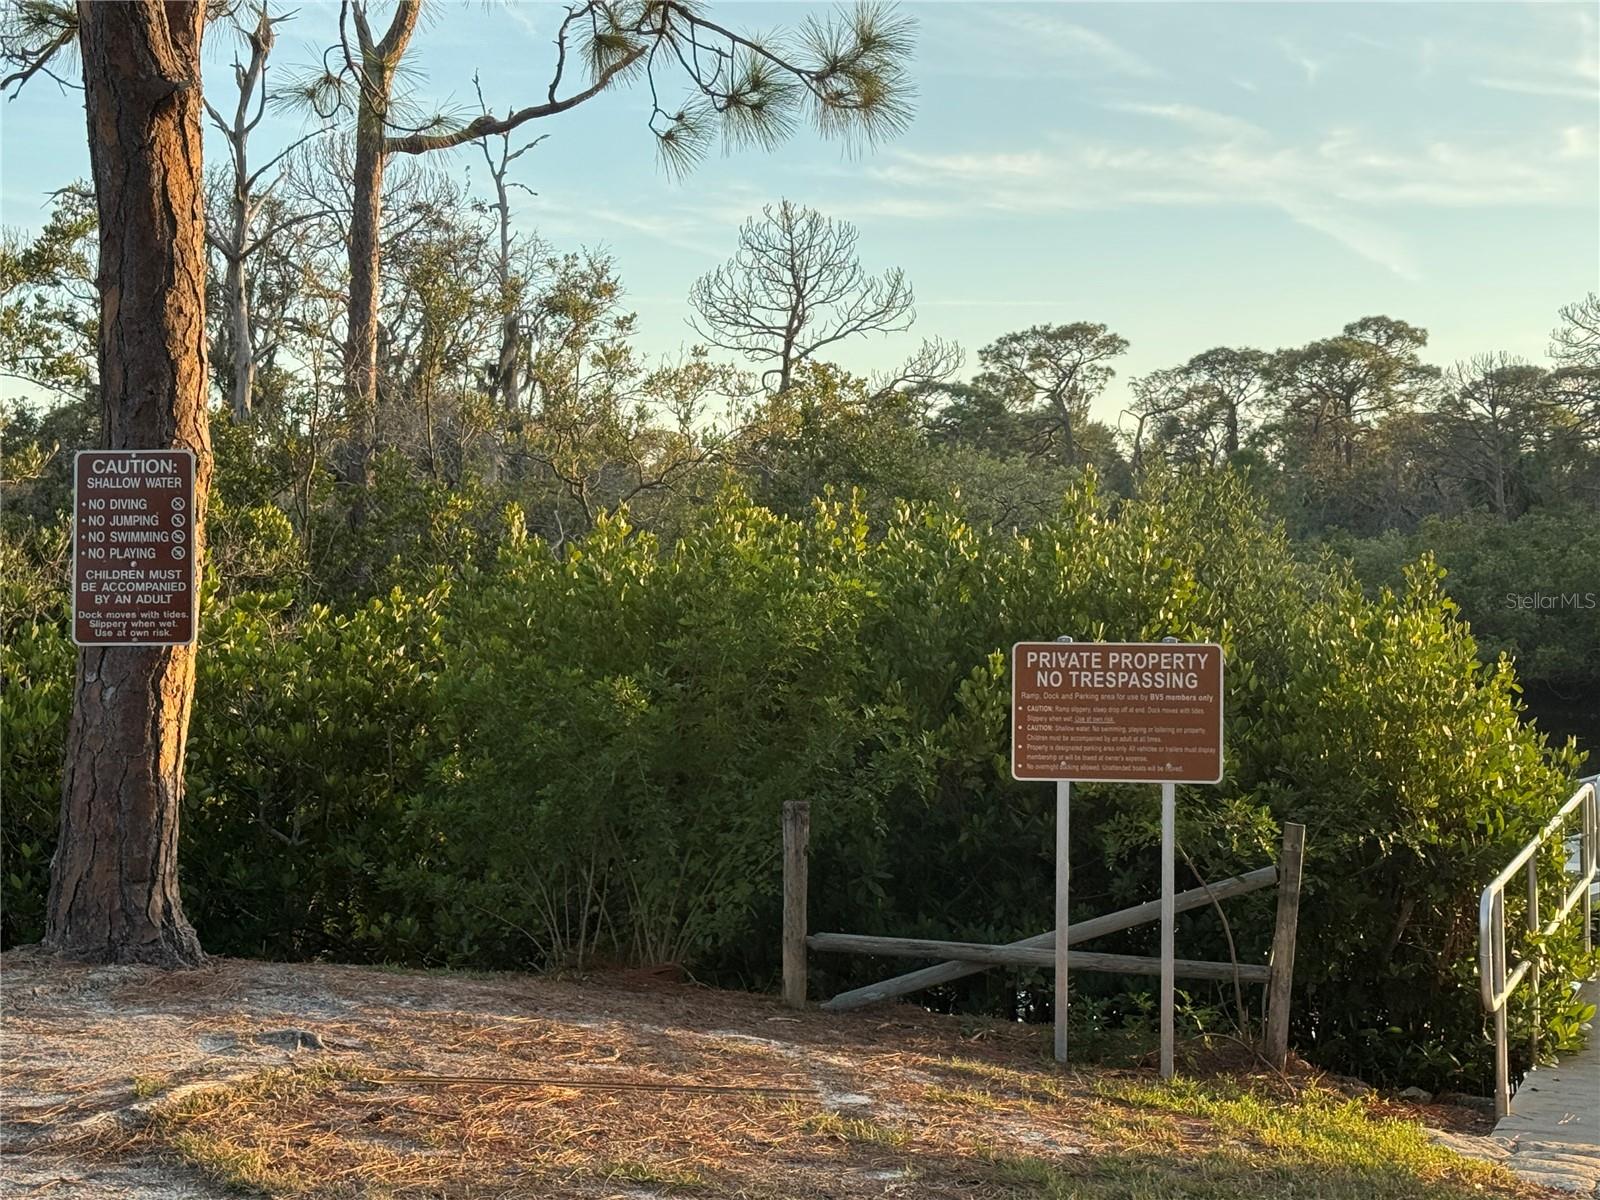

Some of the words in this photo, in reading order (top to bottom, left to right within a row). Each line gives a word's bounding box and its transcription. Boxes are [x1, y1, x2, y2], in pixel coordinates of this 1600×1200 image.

[92, 459, 177, 474] CAUTION:
[87, 477, 140, 488] SHALLOW
[145, 477, 181, 488] WATER
[89, 499, 105, 510] NO
[110, 499, 147, 510] DIVING
[89, 515, 105, 526] NO
[110, 515, 159, 526] JUMPING
[89, 532, 105, 542] NO
[110, 532, 168, 542] SWIMMING
[88, 548, 104, 559] NO
[110, 548, 156, 559] PLAYING
[86, 570, 144, 579] CHILDREN
[149, 570, 182, 579] MUST
[81, 582, 96, 591] BE
[102, 582, 186, 592] ACCOMPANIED
[95, 595, 110, 604] BY
[115, 595, 132, 604] AN
[136, 595, 172, 604] ADULT
[79, 611, 102, 619] Dock
[141, 611, 159, 619] with
[163, 611, 188, 619] tides.
[90, 620, 126, 629] Slippery
[131, 620, 155, 628] when
[95, 629, 112, 637] Use
[153, 629, 171, 637] risk.
[1027, 652, 1101, 668] PRIVATE
[1109, 653, 1208, 669] PROPERTY
[1037, 671, 1062, 687] NO
[1069, 672, 1198, 688] TRESPASSING
[1075, 692, 1099, 701] Parking
